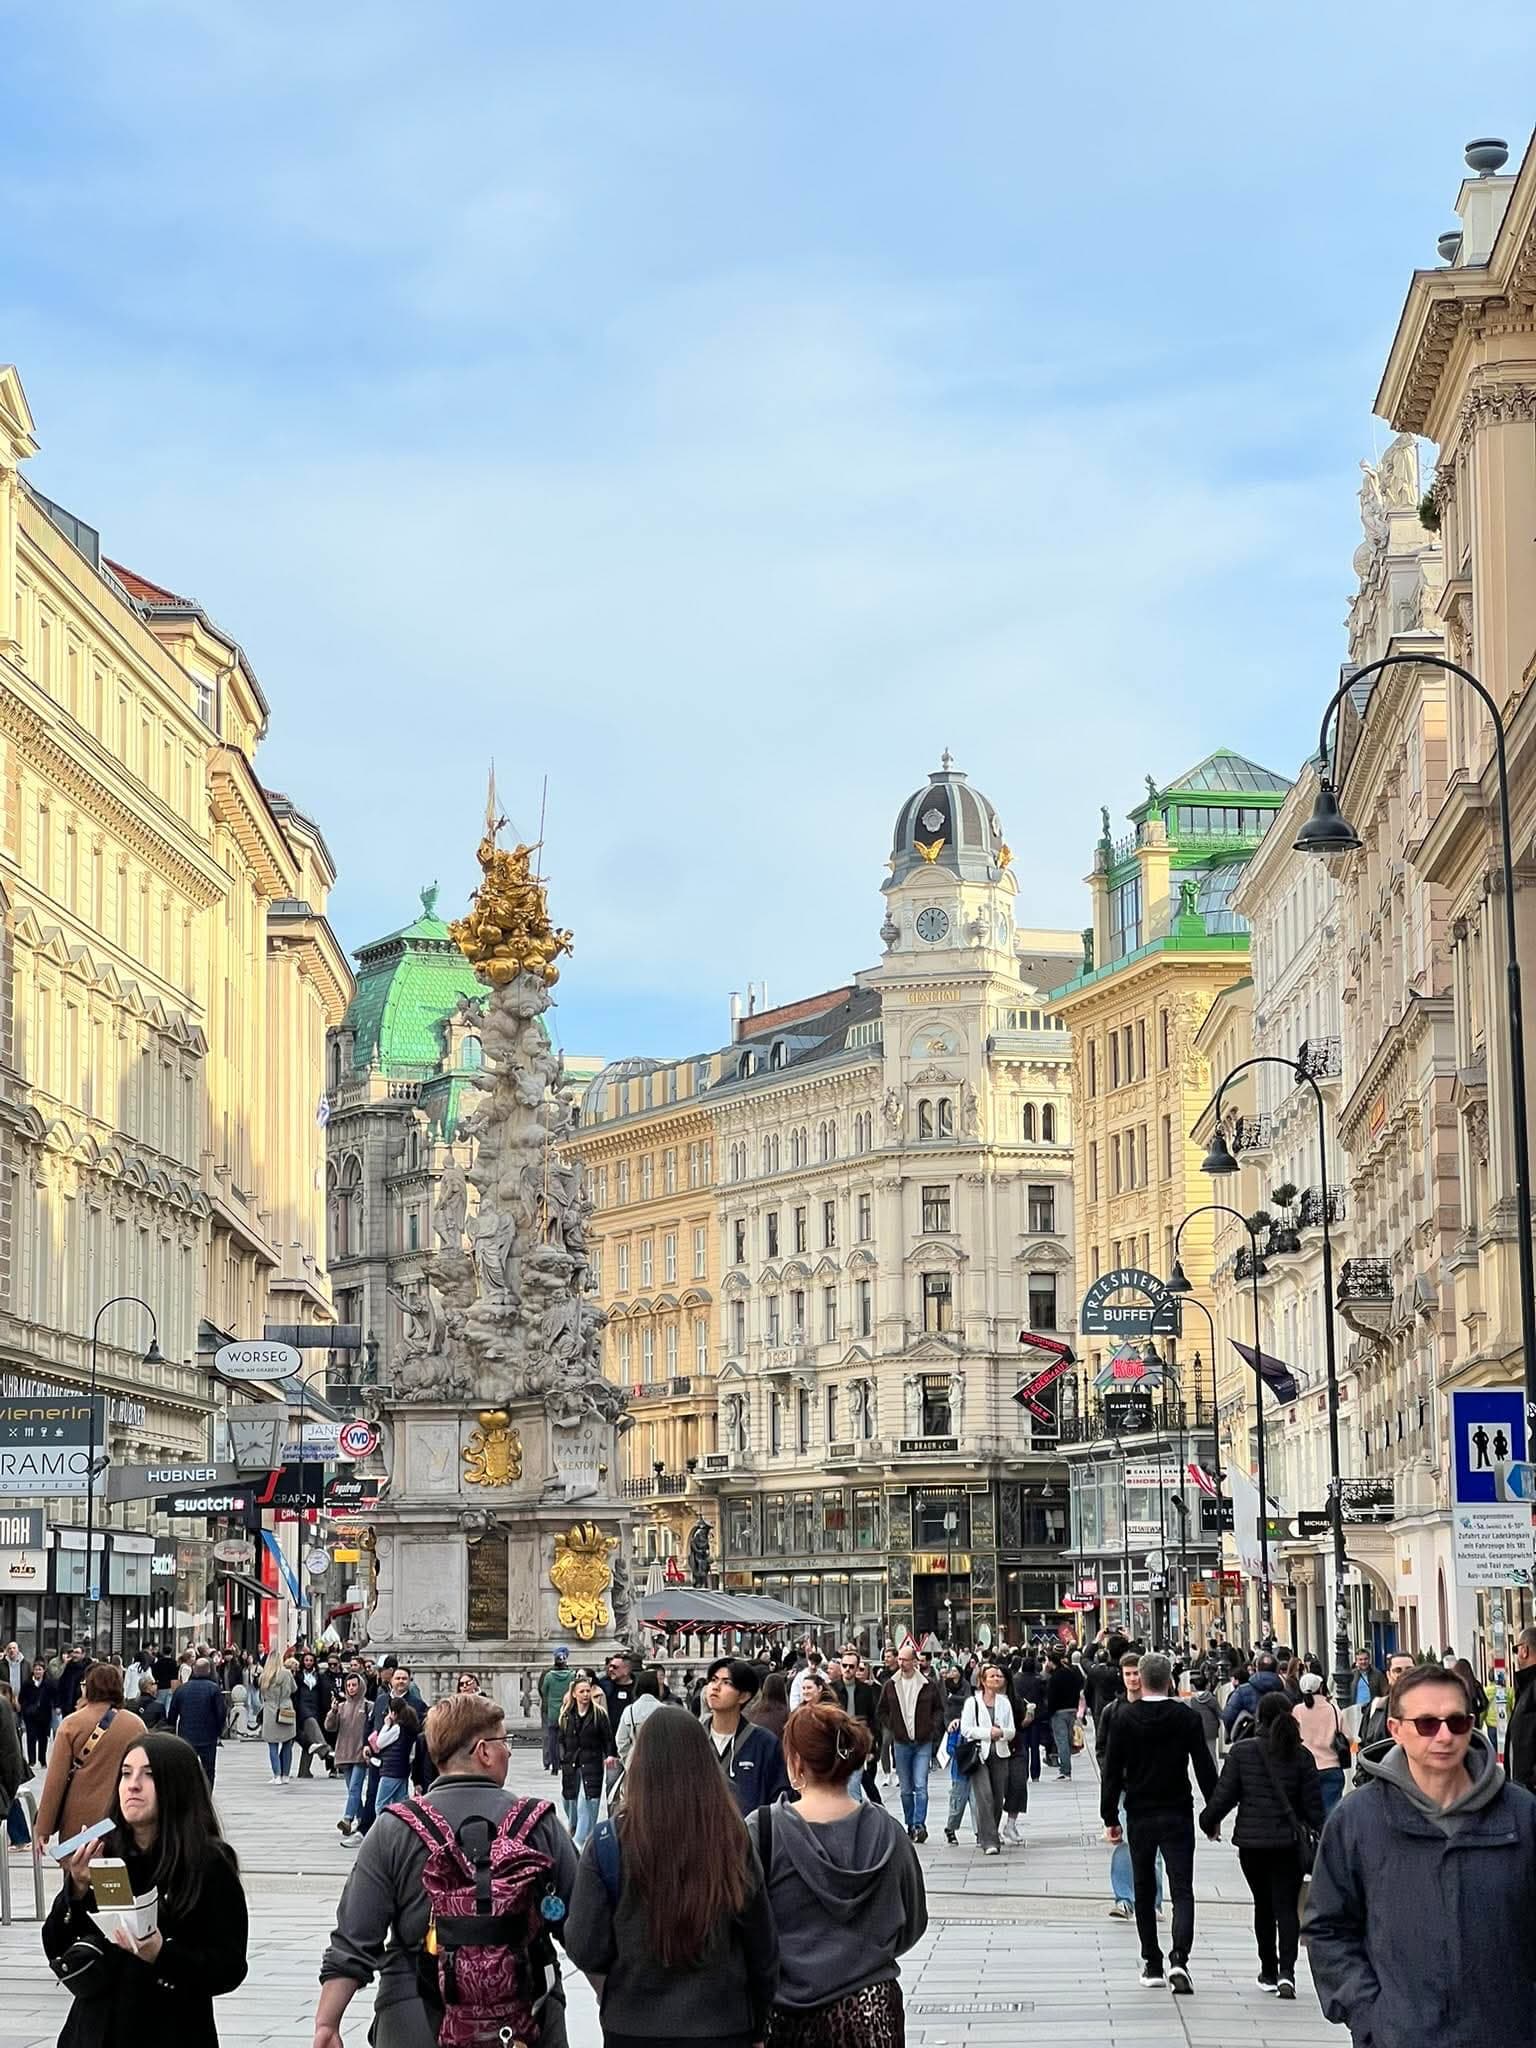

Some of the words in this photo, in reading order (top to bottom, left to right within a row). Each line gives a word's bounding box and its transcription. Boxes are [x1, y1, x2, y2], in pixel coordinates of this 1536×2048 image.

[1103, 1309, 1156, 1321] BUFFET
[227, 1351, 288, 1362] WORSEG
[147, 1468, 218, 1482] HÜBNER
[174, 1496, 233, 1512] swatch
